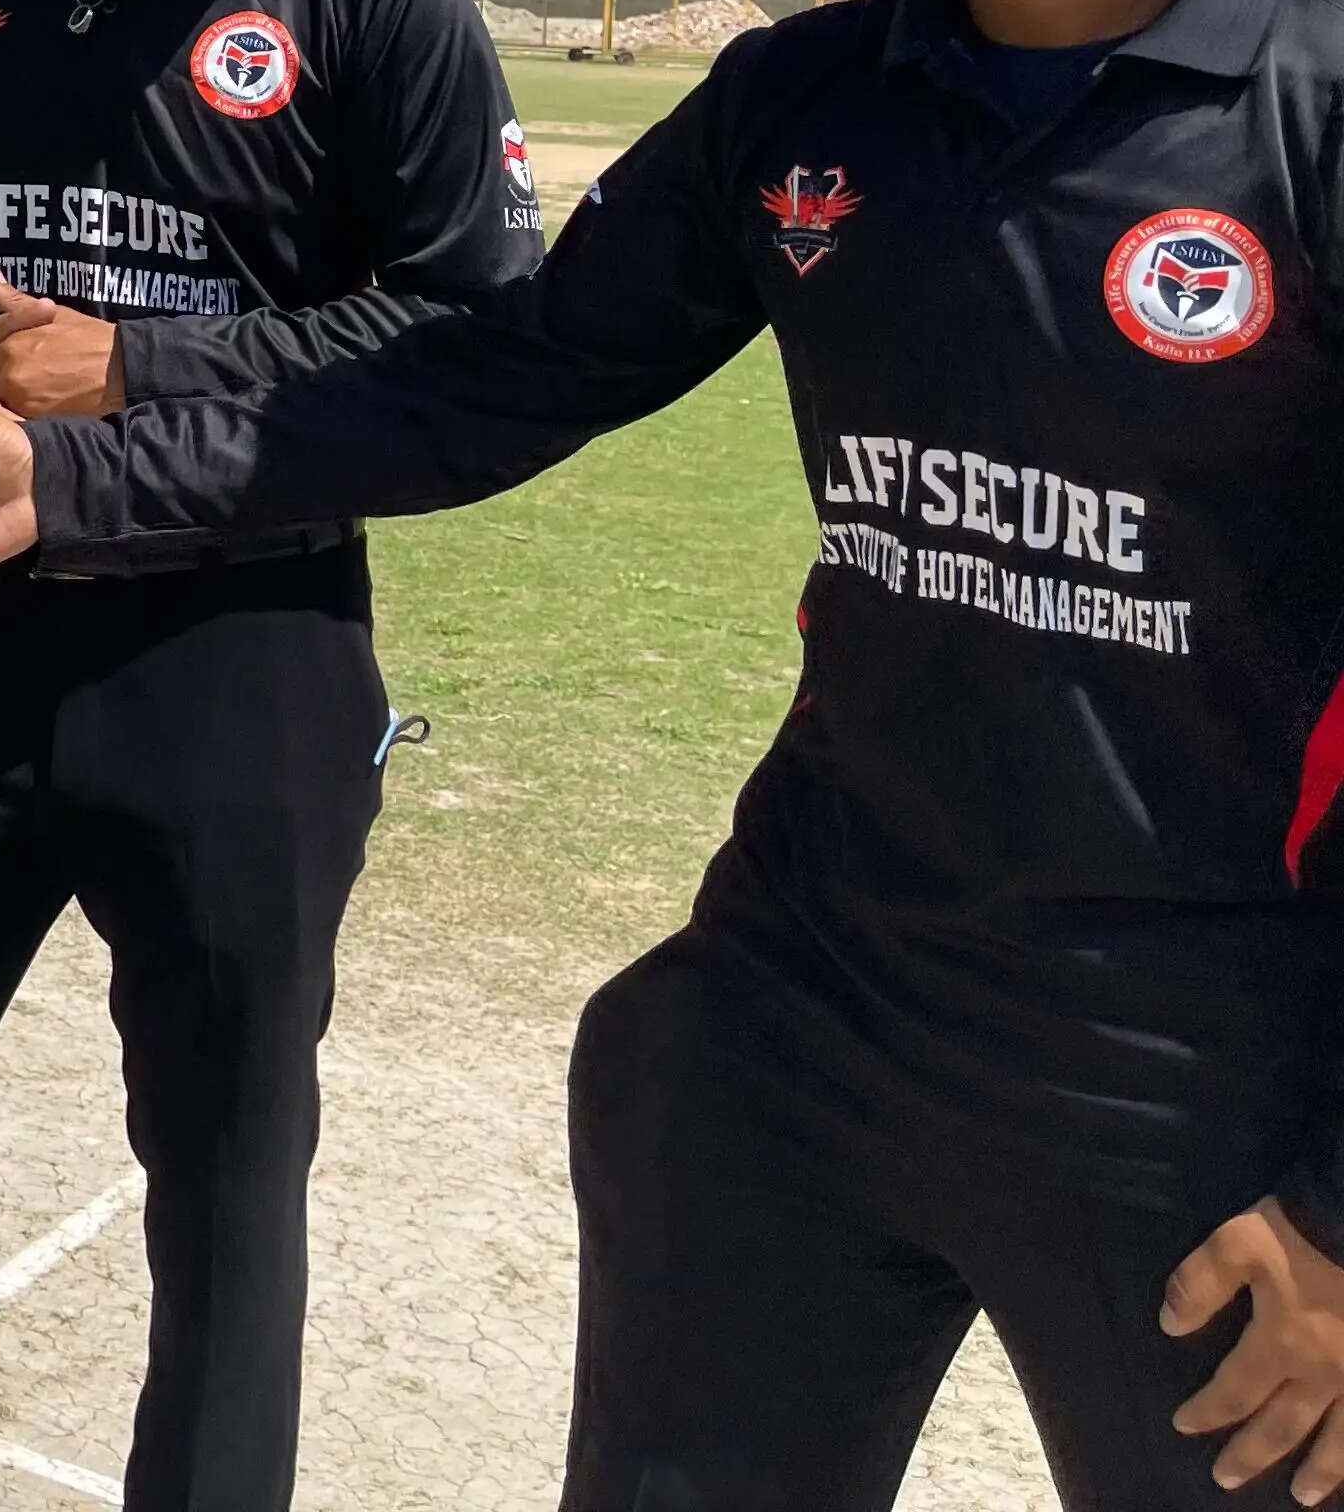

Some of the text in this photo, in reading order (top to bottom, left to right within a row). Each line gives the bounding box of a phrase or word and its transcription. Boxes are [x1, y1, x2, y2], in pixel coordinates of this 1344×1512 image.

[59, 185, 209, 261] SECURE
[1110, 237, 1140, 282] Secure
[1137, 214, 1201, 240] Institute
[1202, 215, 1218, 227] of
[1221, 222, 1258, 255] Hotel
[33, 257, 54, 295] OF
[919, 448, 1146, 573] SECURE
